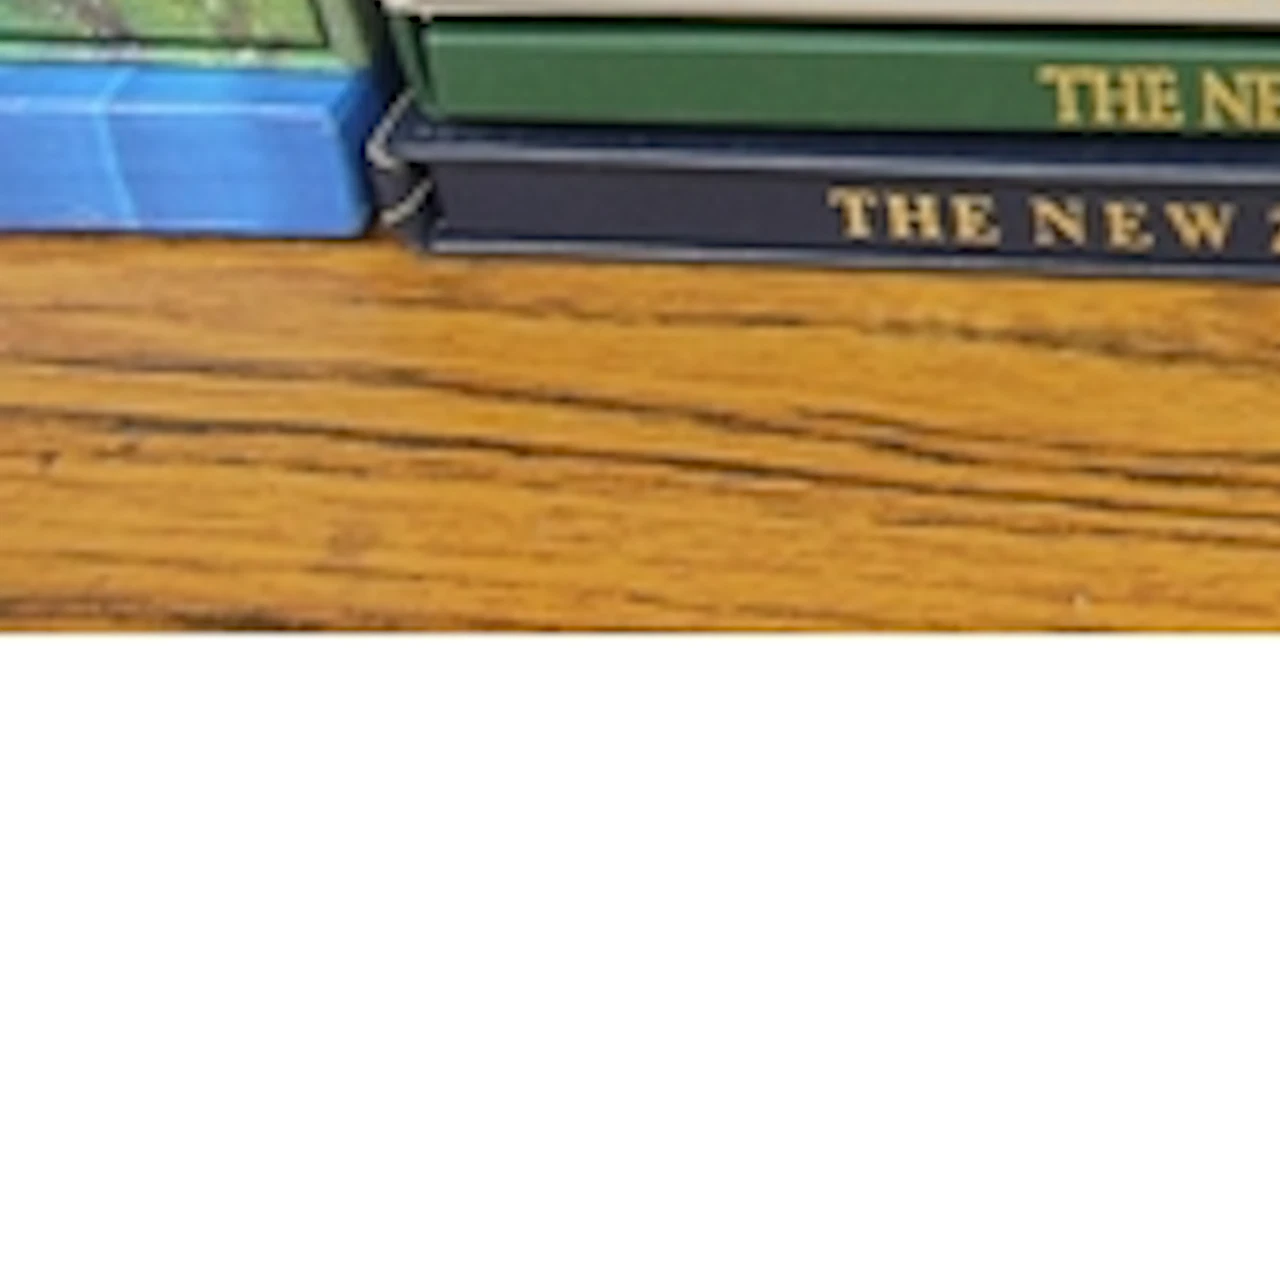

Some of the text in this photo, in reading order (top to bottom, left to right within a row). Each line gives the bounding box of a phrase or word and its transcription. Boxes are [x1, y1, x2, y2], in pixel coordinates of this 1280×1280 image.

[1037, 64, 1184, 128] THE
[828, 187, 1000, 246] THE
[1030, 197, 1234, 254] NEW
